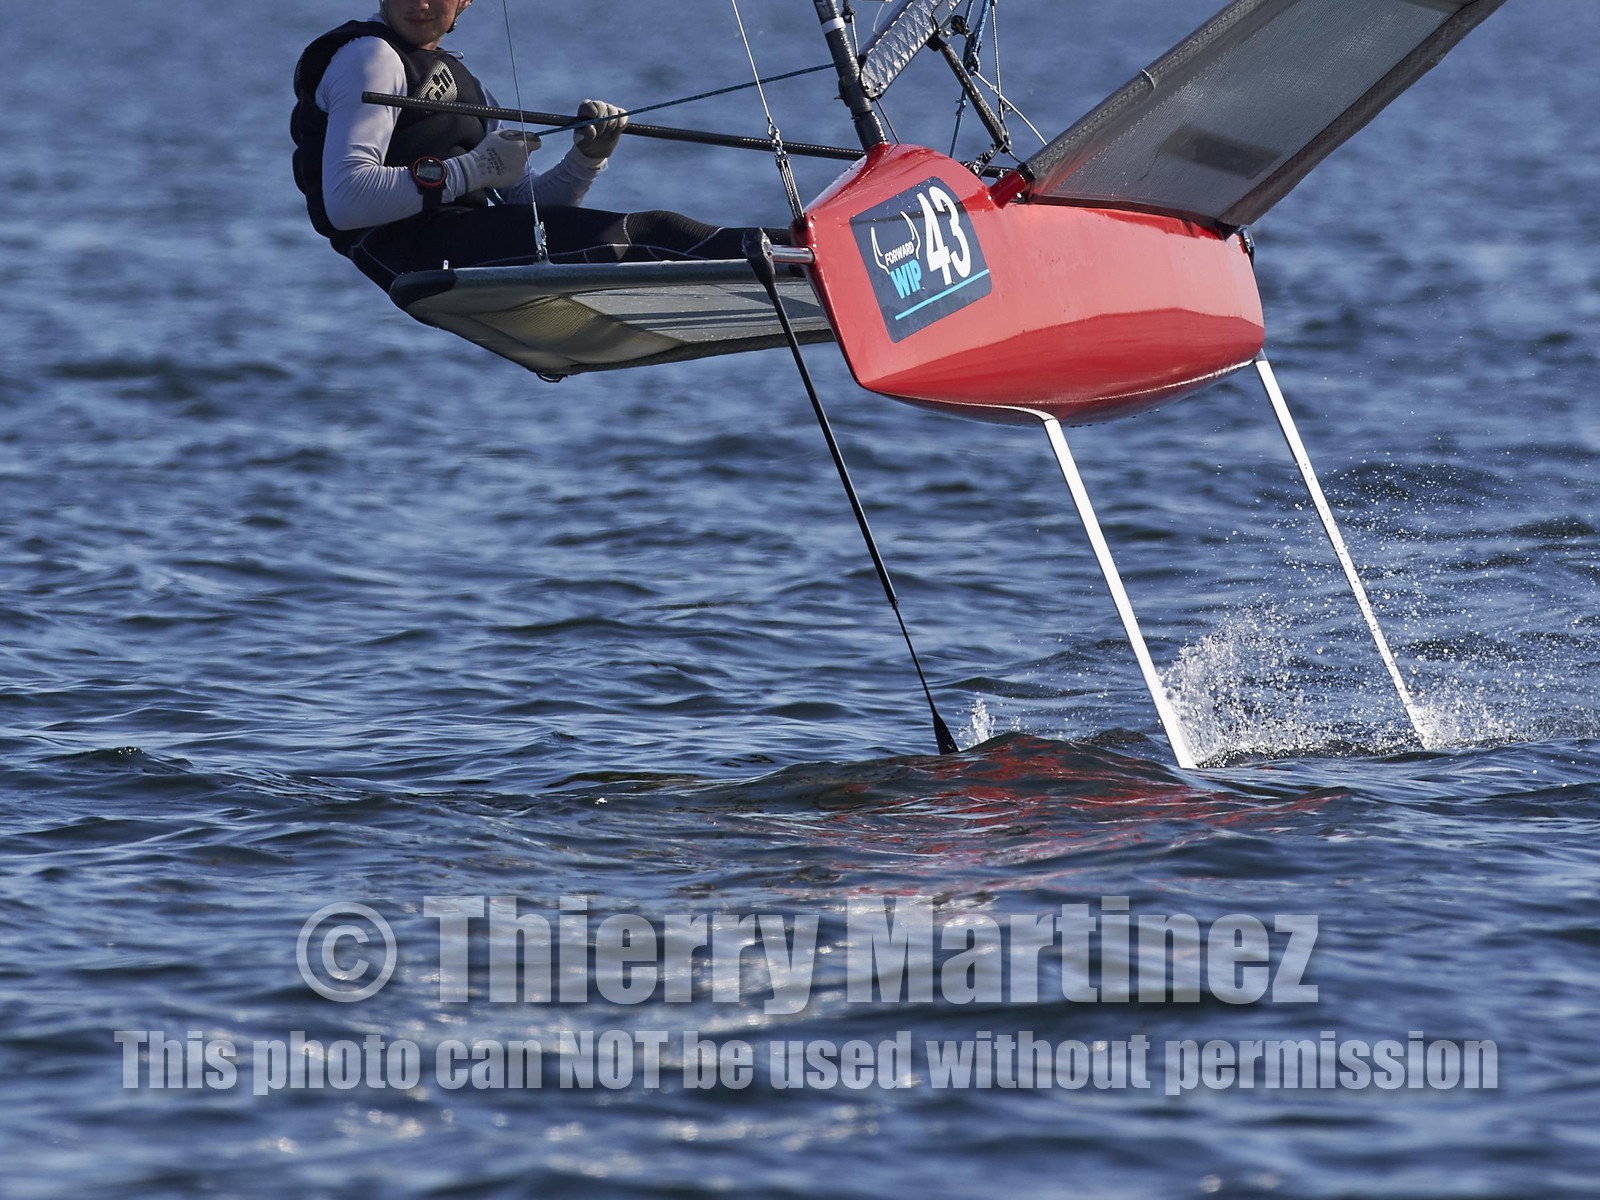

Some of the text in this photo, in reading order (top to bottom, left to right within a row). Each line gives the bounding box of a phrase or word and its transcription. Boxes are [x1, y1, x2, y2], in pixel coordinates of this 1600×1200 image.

[884, 241, 915, 267] FORWARD
[916, 186, 971, 286] 43
[890, 259, 922, 299] WIP
